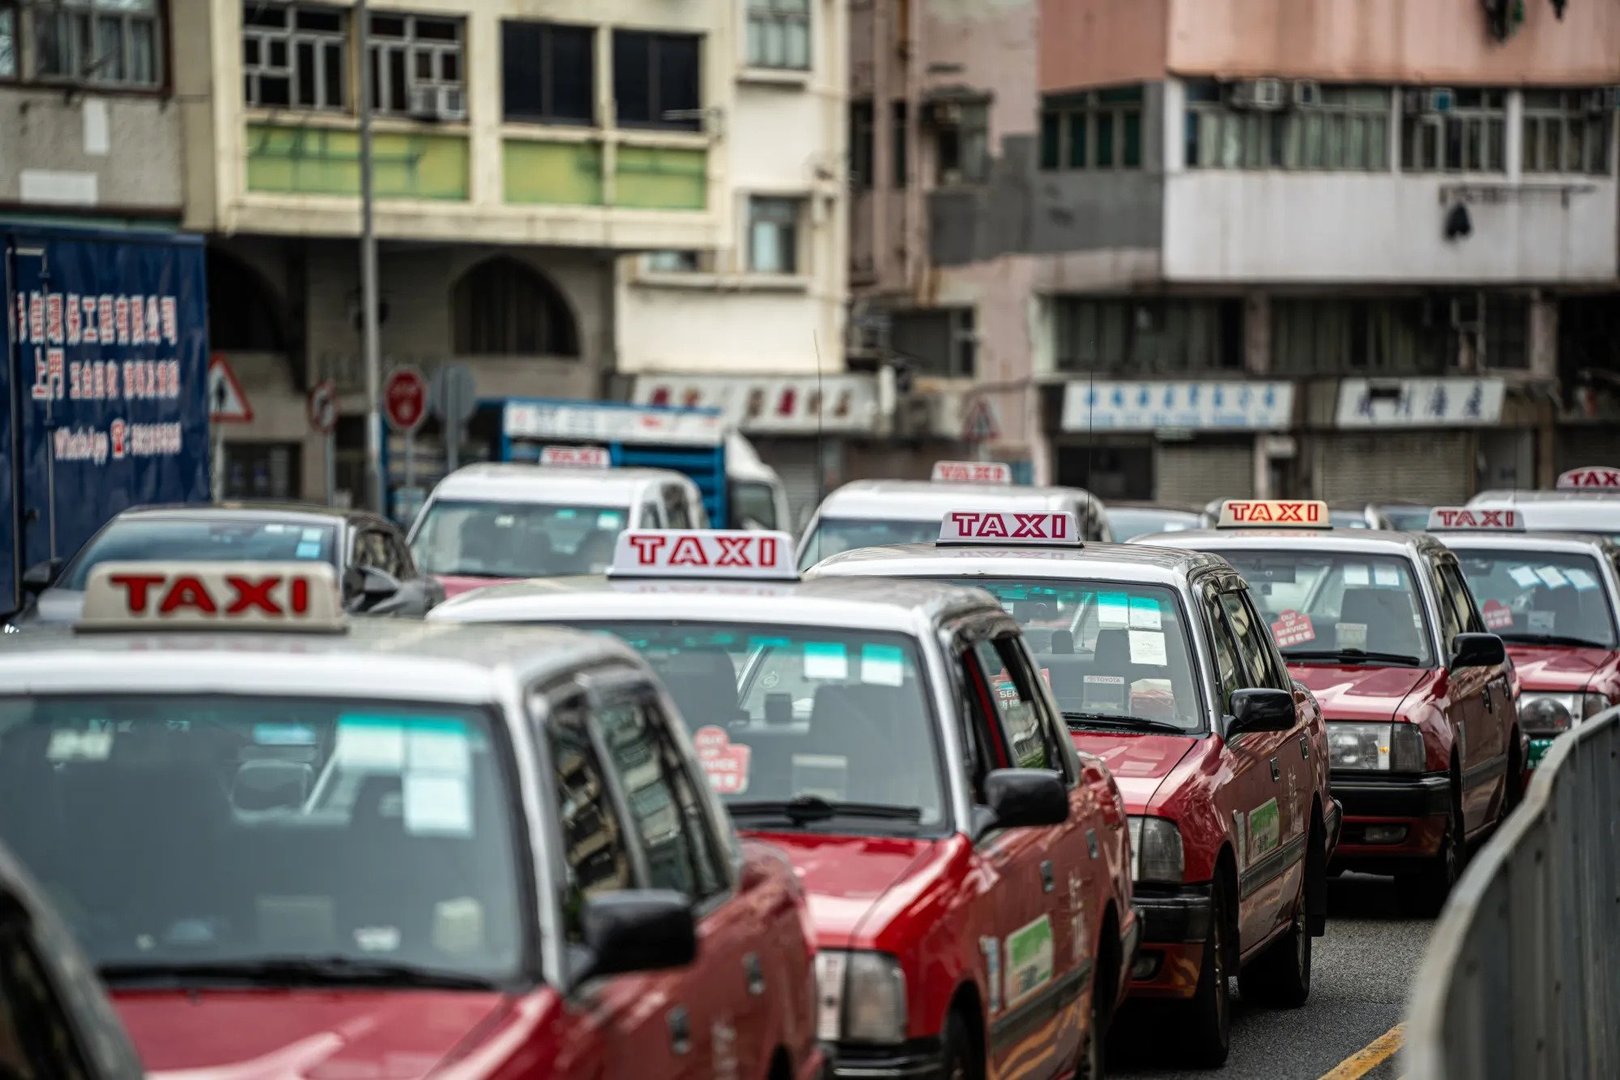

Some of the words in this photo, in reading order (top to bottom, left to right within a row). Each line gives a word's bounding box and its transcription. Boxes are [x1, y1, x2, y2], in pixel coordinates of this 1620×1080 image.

[939, 463, 1004, 481] TAXI
[1229, 503, 1319, 522] TAXI
[1438, 511, 1515, 527] TAXI
[951, 512, 1067, 539] TAXI
[629, 535, 777, 567] TAXI
[109, 574, 309, 615] TAXI
